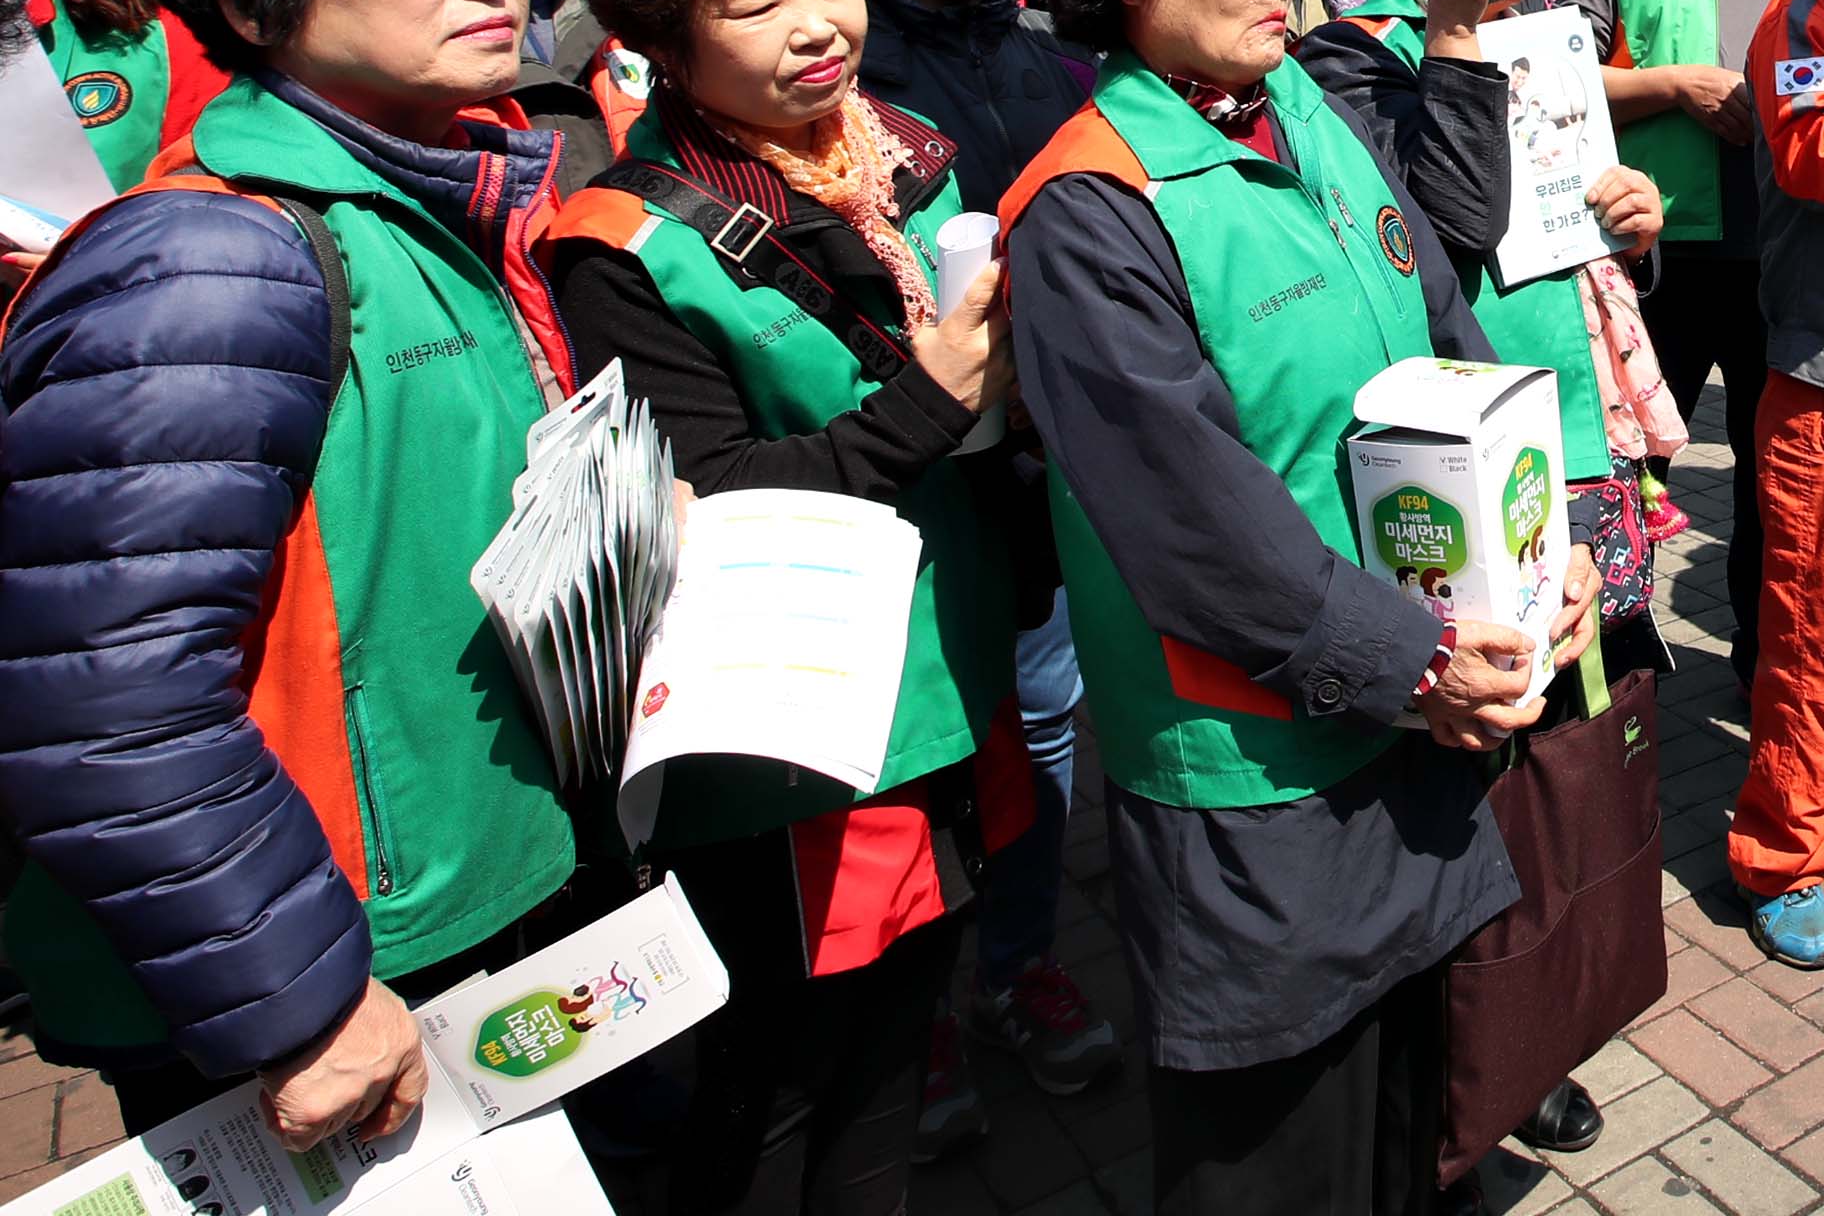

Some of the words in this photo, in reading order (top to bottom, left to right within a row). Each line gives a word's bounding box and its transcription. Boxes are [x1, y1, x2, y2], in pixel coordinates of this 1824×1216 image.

[1535, 174, 1583, 198] 우리집은
[1247, 272, 1328, 323] 인천동구자율방재단
[1398, 495, 1429, 511] KF94
[1508, 473, 1545, 521] 미세먼지
[1384, 521, 1453, 545] 미세먼지
[1395, 543, 1447, 563] 마스크
[504, 1008, 548, 1064] 미세먼지
[530, 1004, 566, 1047] 마스크
[480, 1039, 508, 1066] KF94
